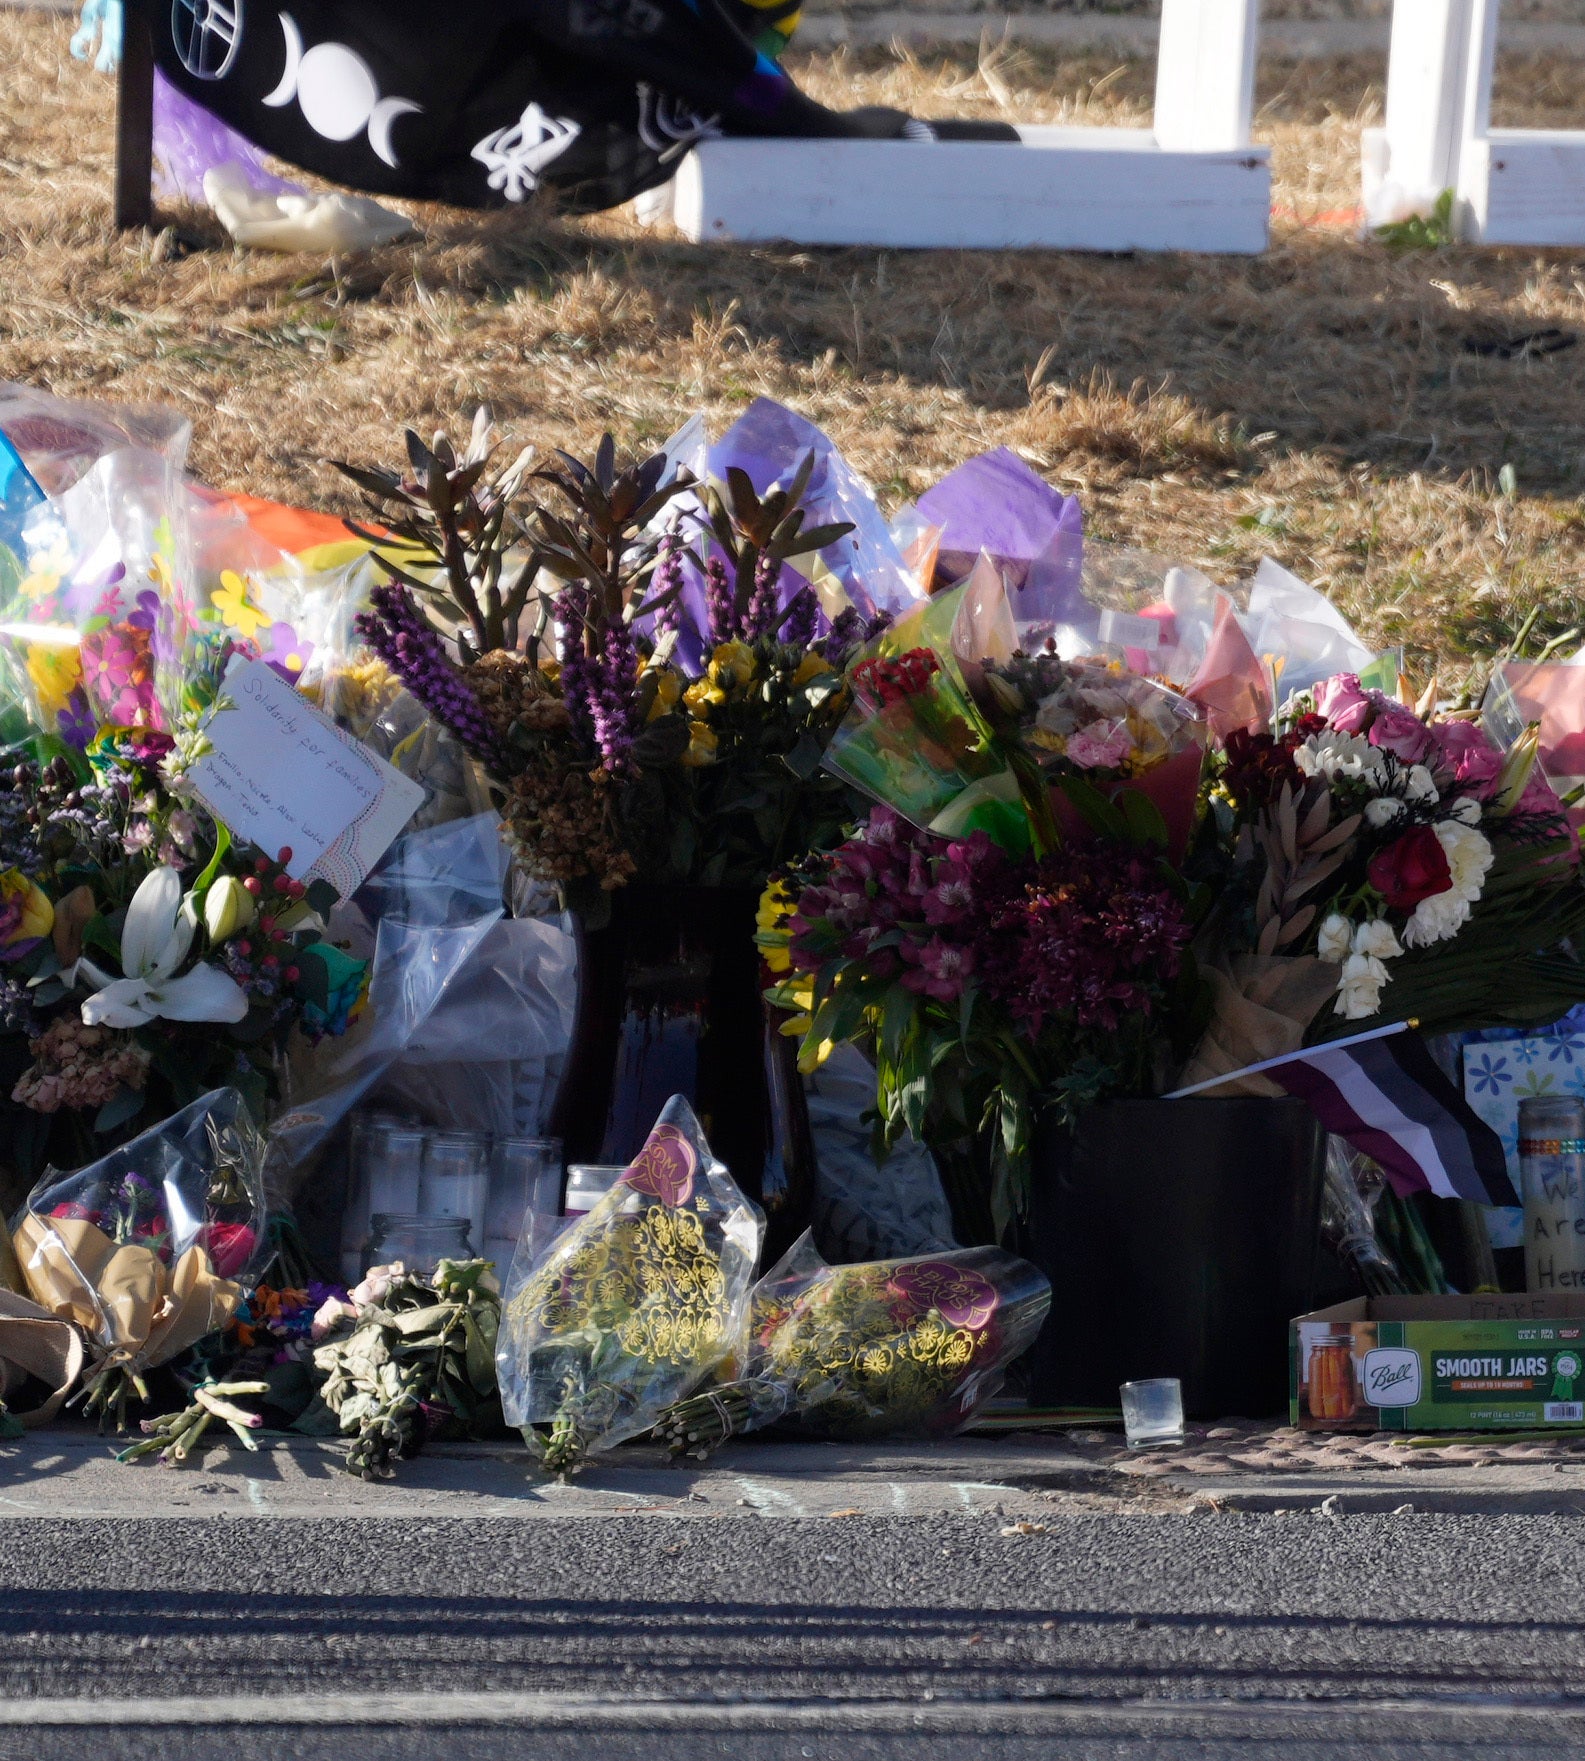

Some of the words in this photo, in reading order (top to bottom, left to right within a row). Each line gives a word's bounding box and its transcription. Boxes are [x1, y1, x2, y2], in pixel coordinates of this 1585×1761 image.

[244, 678, 297, 735] Solidarity
[1370, 1363, 1413, 1391] Ball
[1436, 1357, 1503, 1378] SMOOTH
[1506, 1357, 1547, 1377] JARS
